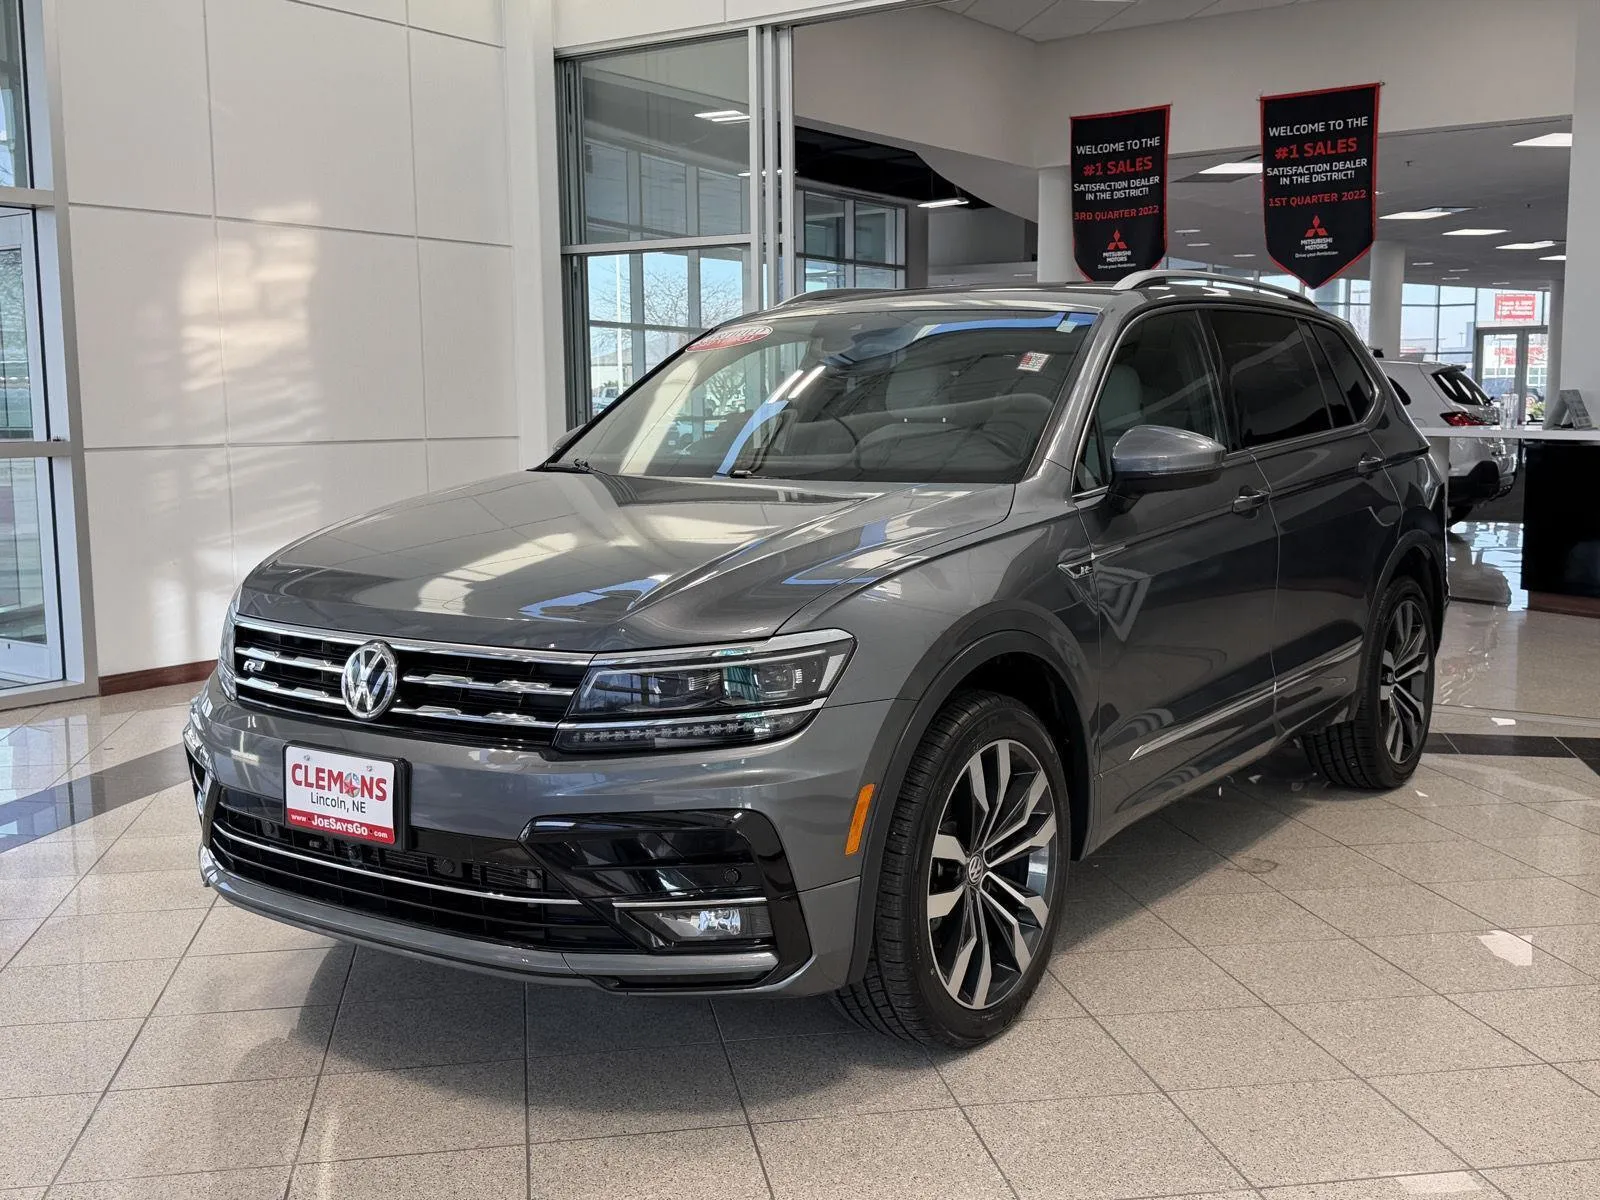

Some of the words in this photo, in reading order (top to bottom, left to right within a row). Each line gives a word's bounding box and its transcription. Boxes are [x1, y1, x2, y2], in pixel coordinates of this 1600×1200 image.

[1269, 122, 1325, 137] WELCOME
[1328, 119, 1344, 131] TO
[1346, 116, 1369, 129] THE
[1076, 141, 1125, 155] WELCOME
[1126, 139, 1140, 150] TO
[1141, 136, 1161, 148] THE
[1274, 144, 1299, 160] #1
[1303, 137, 1358, 158] SALES
[1083, 162, 1104, 177] #1
[1107, 156, 1153, 175] SALES
[1266, 163, 1331, 177] SATISFACTION
[1332, 158, 1368, 171] DEALER
[1073, 180, 1128, 192] SATISFACTION
[1130, 176, 1160, 188] DEALER
[1279, 176, 1291, 186] IN
[1291, 174, 1311, 184] THE
[1312, 170, 1355, 183] DISTRICT!
[1085, 192, 1095, 201] IN
[1096, 190, 1112, 200] THE
[1113, 187, 1149, 199] DISTRICT!
[1268, 197, 1288, 207] 1ST
[1289, 193, 1338, 207] QUARTER
[1341, 189, 1367, 201] 2022
[1074, 211, 1093, 221] 3RD
[1094, 208, 1137, 221] QUARTER
[1138, 205, 1160, 216] 2022
[1300, 237, 1333, 246] MITSUBISHI
[1304, 243, 1328, 251] MOTORS
[291, 763, 388, 802] CLEMONS
[310, 791, 350, 813] Lincoln,
[352, 800, 367, 814] NE
